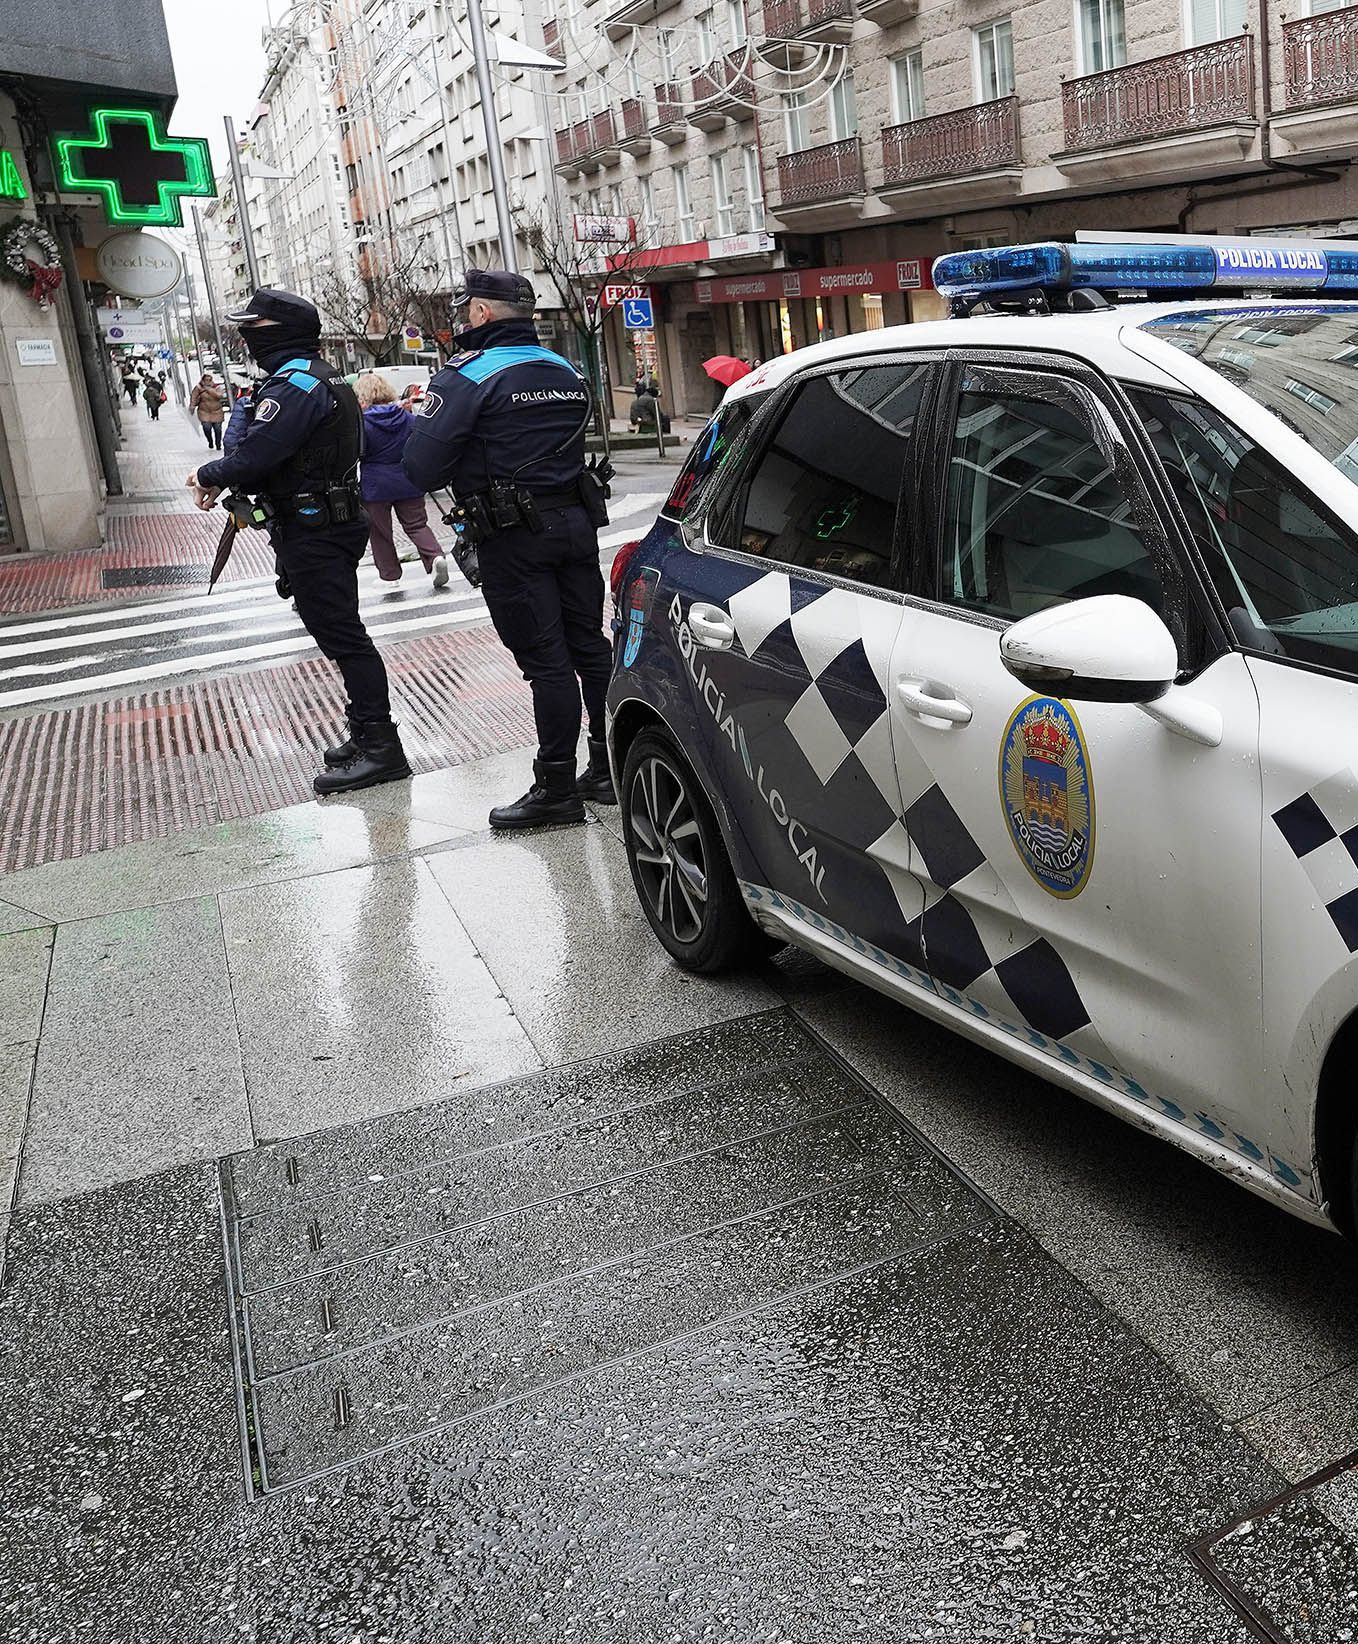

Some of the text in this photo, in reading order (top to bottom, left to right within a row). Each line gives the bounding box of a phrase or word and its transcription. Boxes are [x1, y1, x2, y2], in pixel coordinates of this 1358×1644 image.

[1217, 248, 1324, 270] POLICIA LOCAL
[820, 268, 873, 291] supermercado
[607, 286, 648, 299] FROIZ
[511, 389, 587, 403] POLICÍA LOCA
[757, 764, 829, 906] LOCAL
[1014, 812, 1084, 868] POLICIA LOCAL
[1036, 866, 1072, 886] PONTEVEDRA
